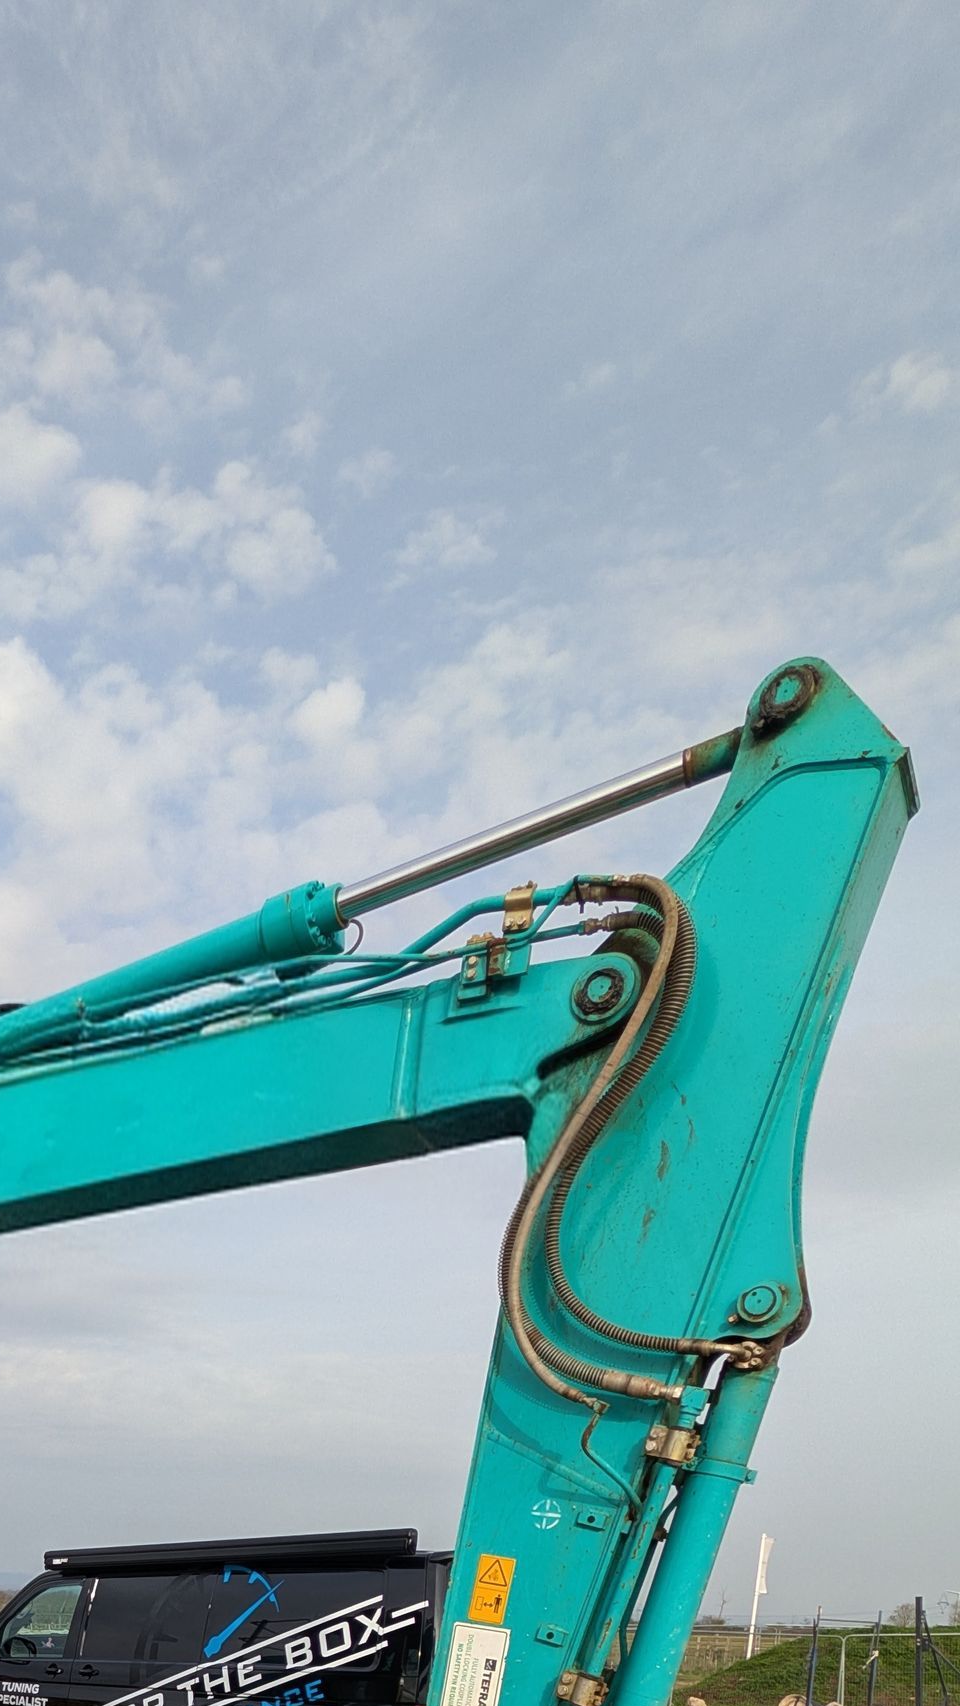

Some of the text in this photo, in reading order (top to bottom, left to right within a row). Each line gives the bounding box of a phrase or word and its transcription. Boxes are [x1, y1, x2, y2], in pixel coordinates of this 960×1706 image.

[177, 1655, 262, 1706] THE
[285, 1606, 385, 1669] BOX
[457, 1643, 464, 1652] NO
[464, 1634, 474, 1656] DOUBLE
[454, 1653, 462, 1674] SAFETY
[460, 1657, 470, 1682] LOCKING
[1, 1681, 40, 1694] TUNING
[464, 1657, 479, 1706] FULLY AUTOMATIC
